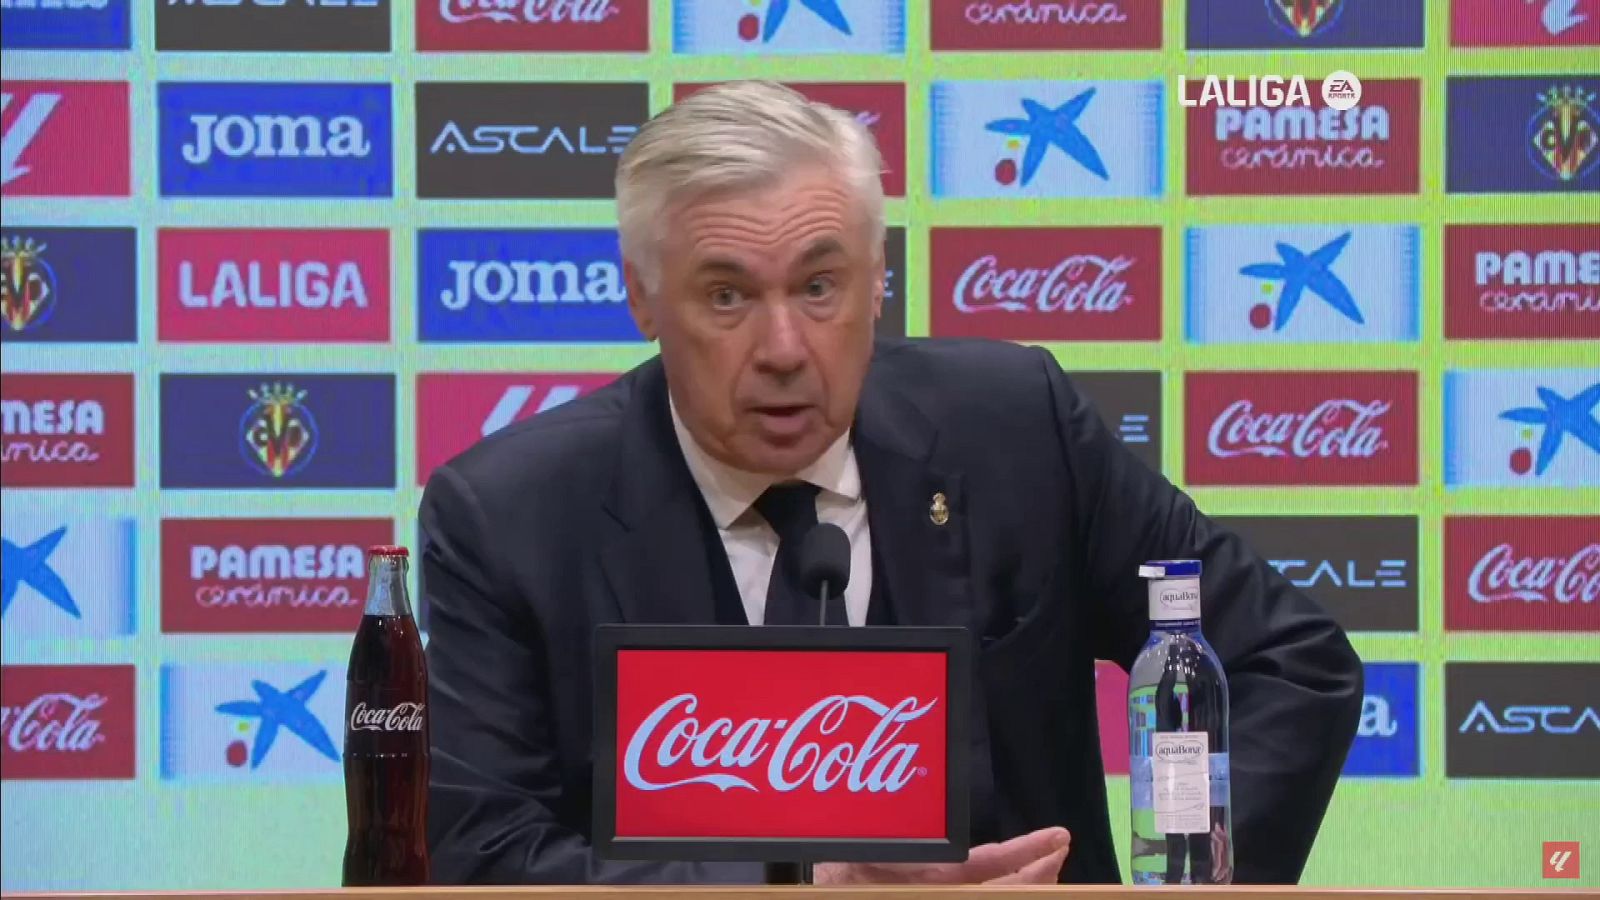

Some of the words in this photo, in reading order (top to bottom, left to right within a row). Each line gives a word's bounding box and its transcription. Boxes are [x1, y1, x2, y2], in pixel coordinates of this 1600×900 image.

[182, 114, 371, 164] Joma
[430, 120, 638, 154] ASCALE
[1215, 106, 1390, 141] PAMESA
[179, 260, 369, 308] LALIGA
[440, 260, 627, 311] Joma
[953, 254, 1137, 313] Coca-Cola
[1208, 398, 1393, 458] Coca-Cola
[190, 544, 365, 580] PAMESA
[351, 701, 426, 731] Coca-Cola
[623, 692, 938, 793] Coca-Cola
